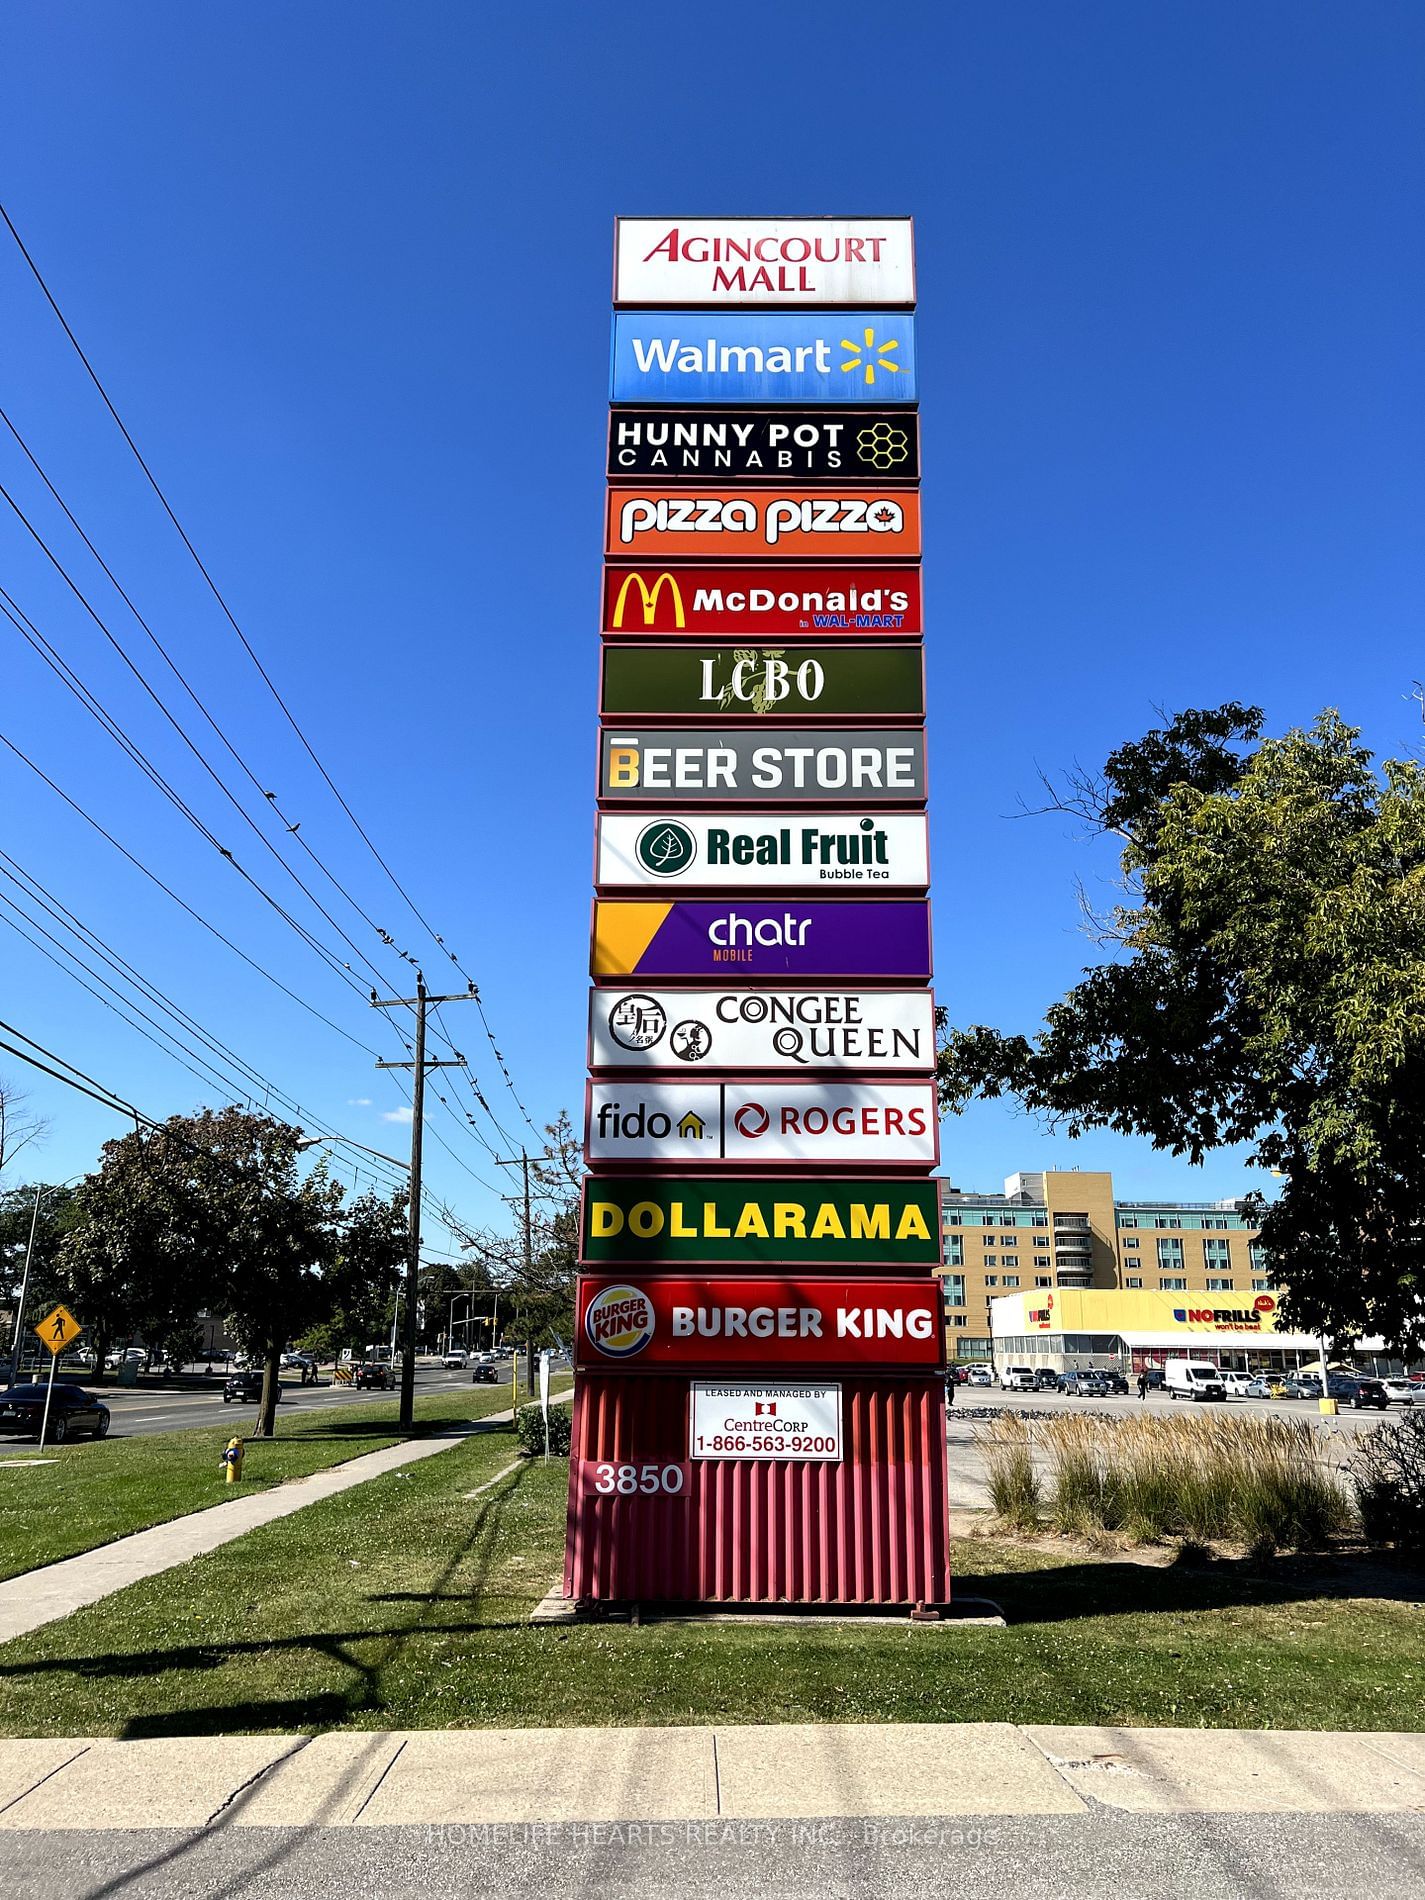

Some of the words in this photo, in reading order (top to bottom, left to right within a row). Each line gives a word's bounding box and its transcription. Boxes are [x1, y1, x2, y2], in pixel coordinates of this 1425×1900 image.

[643, 228, 887, 263] AGINCOURT
[712, 266, 816, 292] MALL
[631, 338, 831, 373] Walmart
[617, 422, 754, 447] HUNNY
[769, 423, 844, 448] POT
[617, 449, 842, 468] CANNABIS
[620, 498, 758, 544] pizza
[765, 499, 904, 545] pizza
[692, 588, 909, 612] McDonald's
[812, 614, 905, 628] WAL-MART
[699, 658, 825, 702] LCBO
[609, 745, 738, 788] BEER
[751, 746, 916, 789] STORE
[707, 828, 791, 865] Real
[801, 818, 889, 865] Fruit
[819, 868, 863, 880] Bubble
[866, 869, 889, 880] Tea
[708, 912, 812, 947] chatr
[713, 949, 753, 962] MOBILE
[715, 995, 864, 1024] CONGEE
[772, 1027, 921, 1063] QUEEN
[597, 1102, 672, 1139] fido
[780, 1106, 927, 1137] ROGERS
[591, 1201, 932, 1240] DOLLARAMA
[593, 1298, 646, 1324] BURGER
[595, 1310, 648, 1343] KING
[672, 1306, 823, 1338] BURGER
[836, 1307, 934, 1339] KING
[1188, 1309, 1261, 1322] NOFRILLS
[705, 1388, 742, 1398] LEASED
[743, 1389, 763, 1398] AND
[765, 1389, 812, 1399] MANAGED
[814, 1390, 826, 1399] BY
[696, 1435, 836, 1453] 1-866-563-9200
[594, 1464, 684, 1495] 3850
